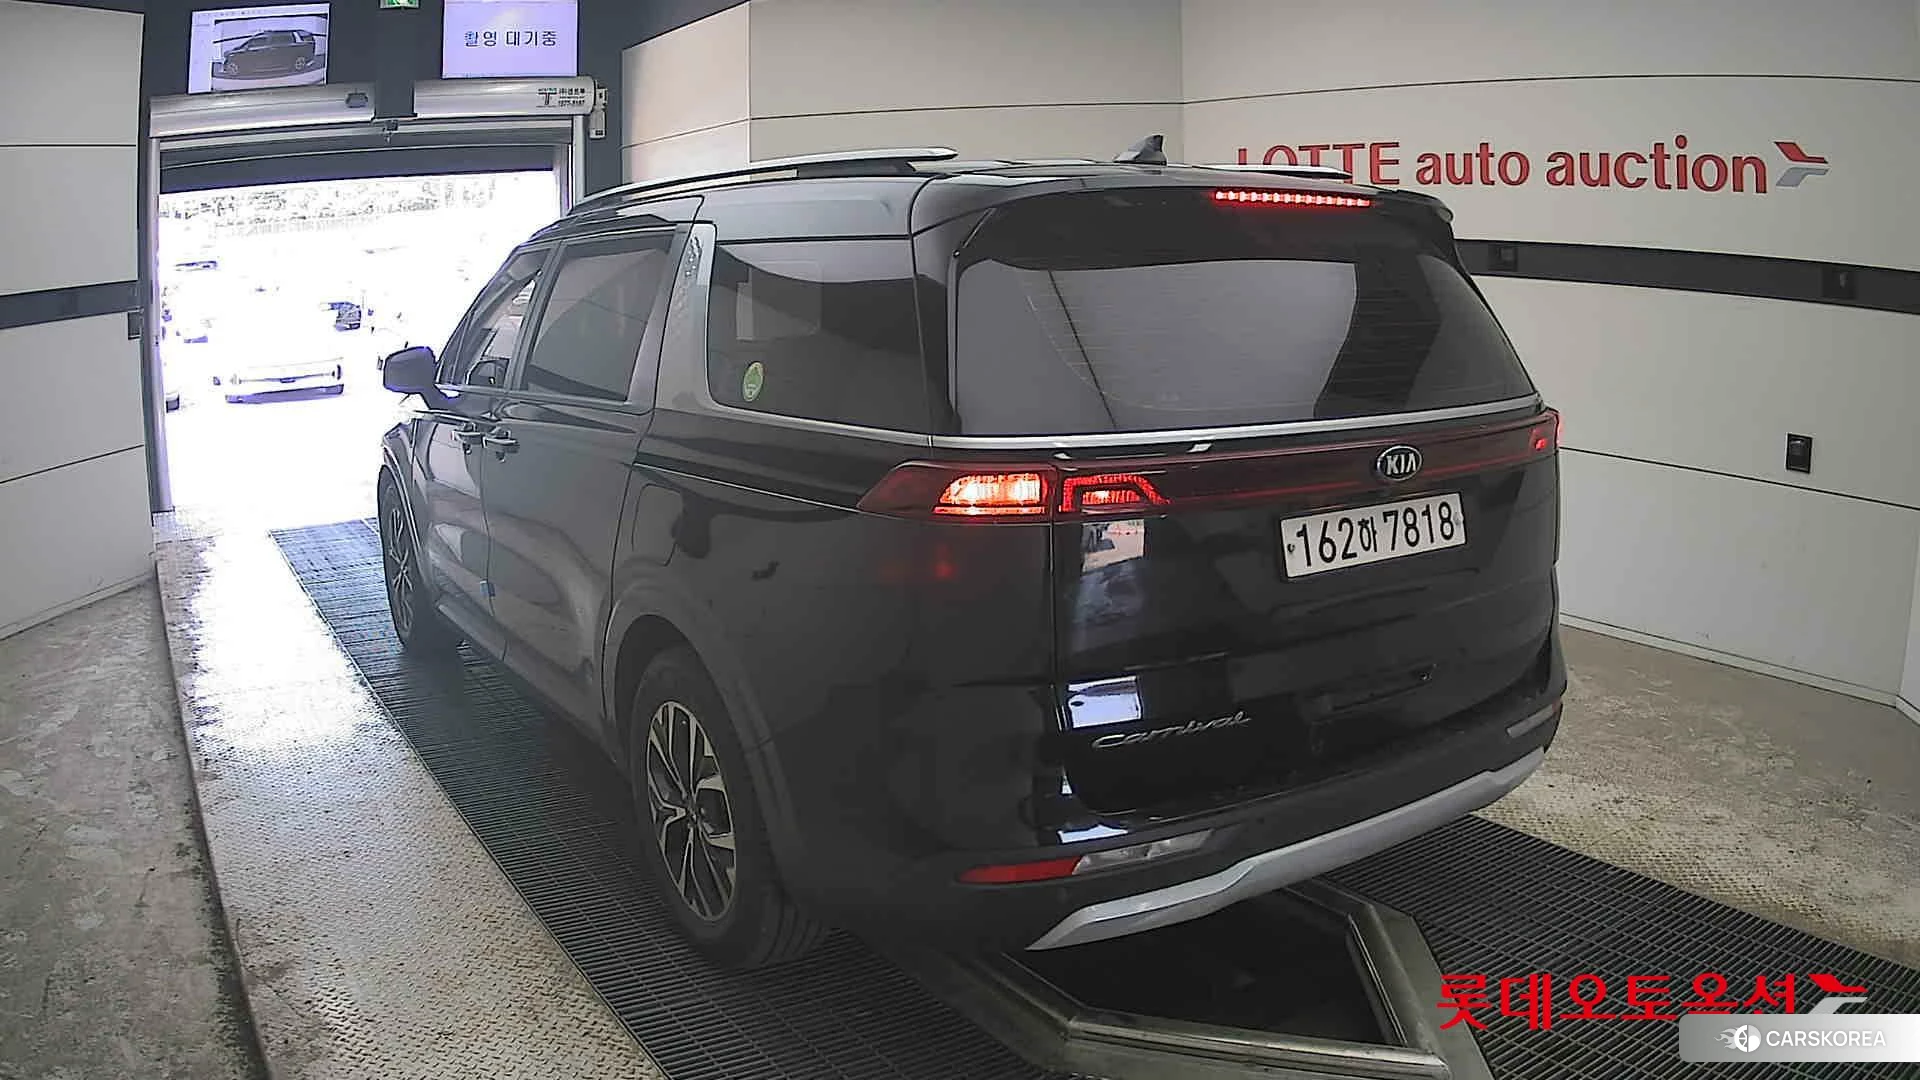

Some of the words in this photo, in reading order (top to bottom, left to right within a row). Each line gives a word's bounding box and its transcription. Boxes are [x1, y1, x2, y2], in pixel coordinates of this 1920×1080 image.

[506, 31, 557, 47] 대기중
[1415, 142, 1530, 187] auto
[1546, 134, 1768, 194] auction
[1386, 452, 1418, 475] KIA
[1296, 516, 1378, 567] 162하
[1382, 501, 1455, 551] 7818
[1092, 711, 1251, 749] Carnival
